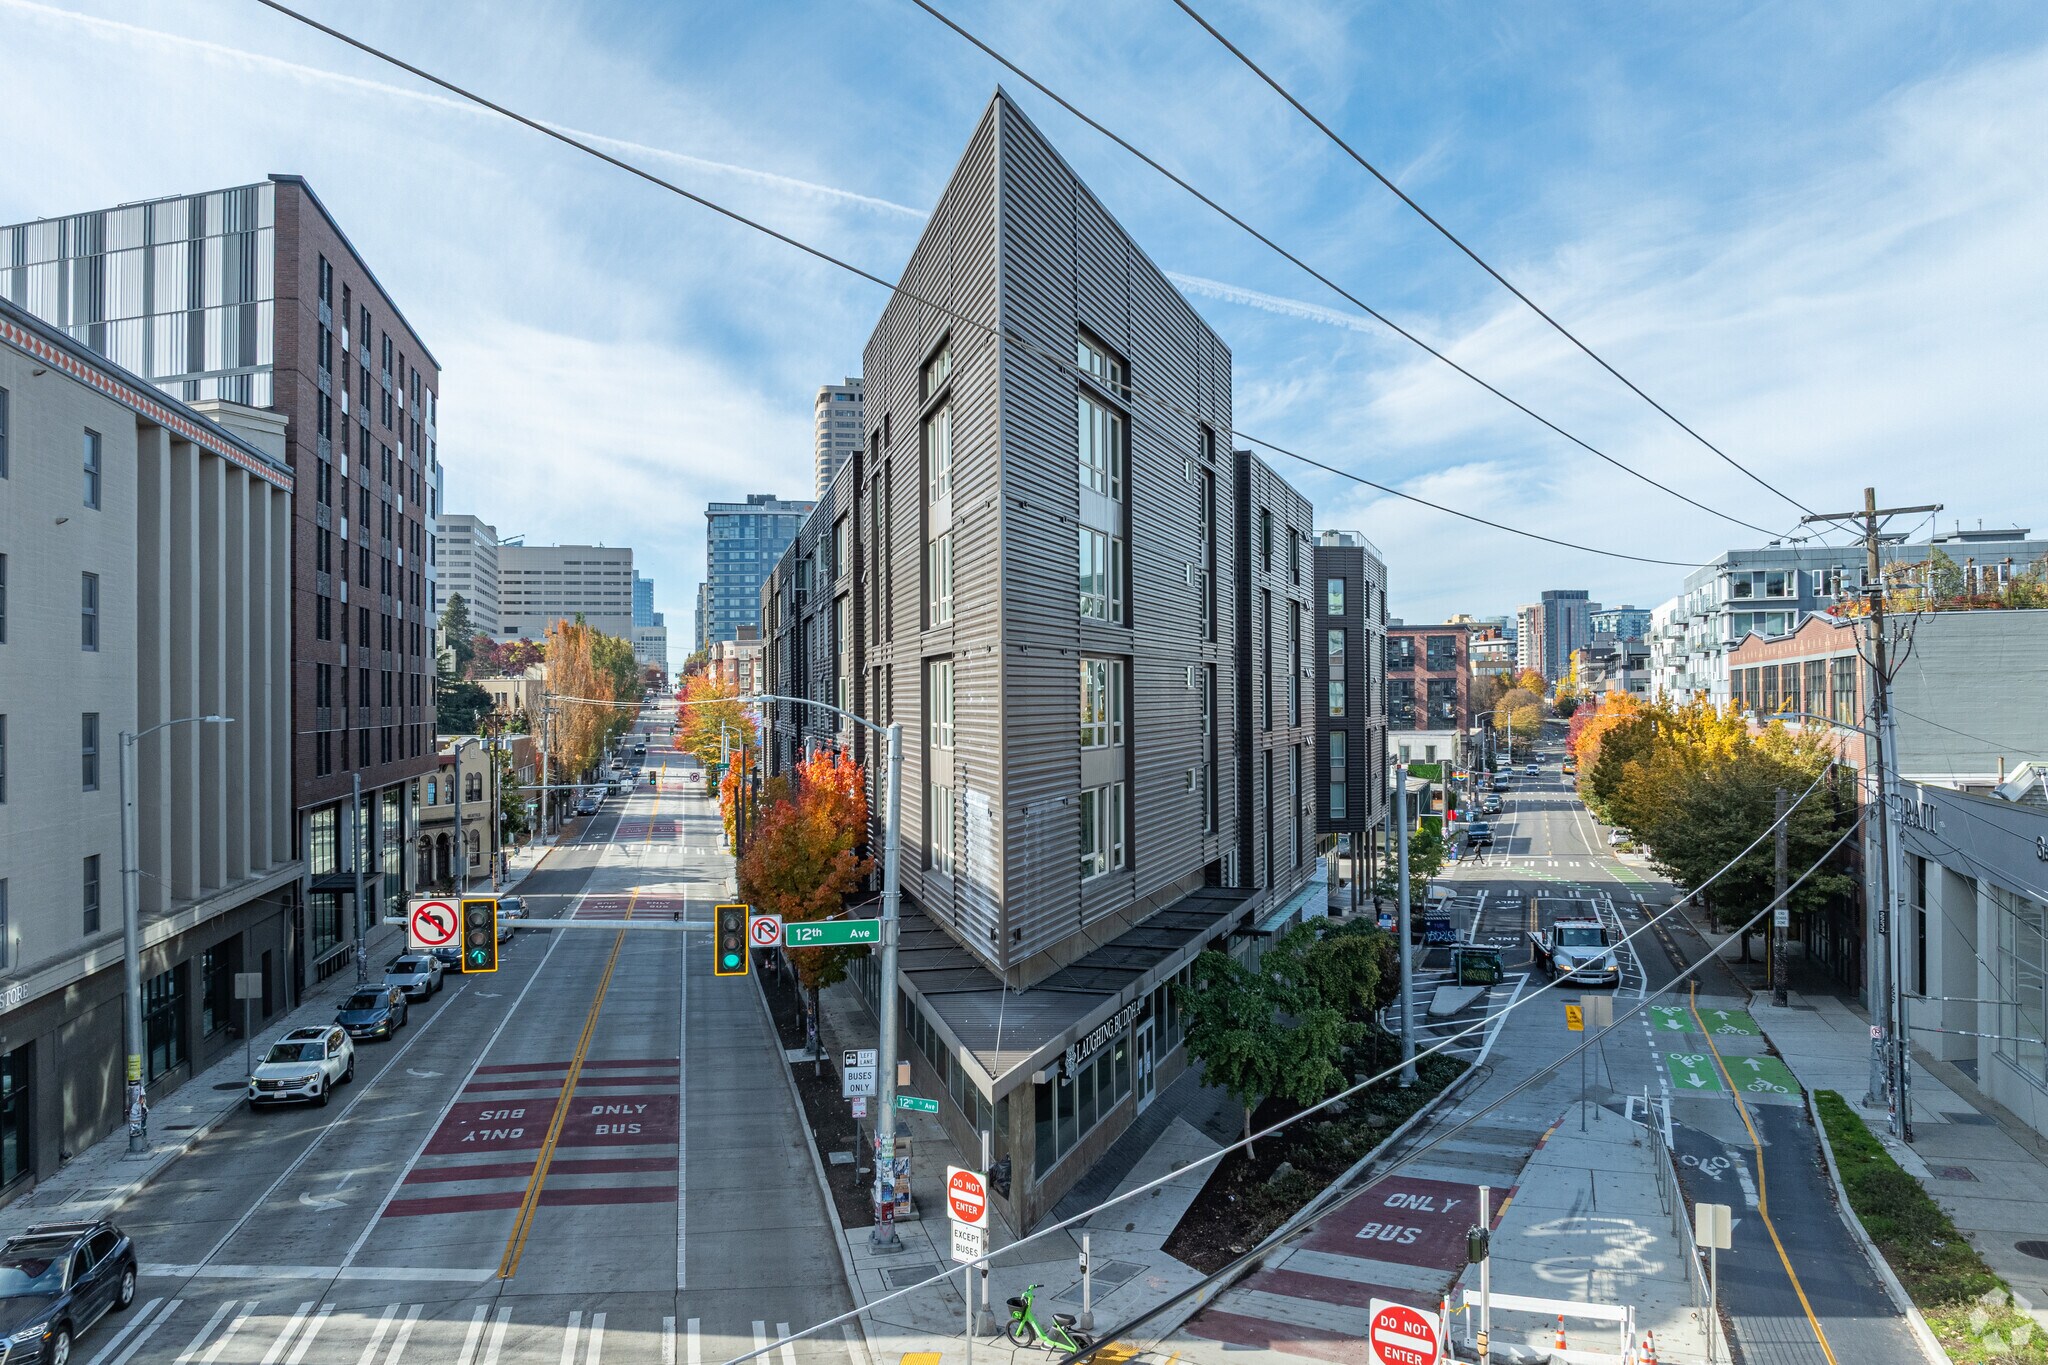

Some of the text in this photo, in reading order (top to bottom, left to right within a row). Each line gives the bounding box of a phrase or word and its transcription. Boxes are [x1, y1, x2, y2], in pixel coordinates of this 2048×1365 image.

[796, 928, 870, 941] 12th Ave
[0, 982, 29, 1009] STORE
[1076, 1000, 1141, 1063] LAUGHING BUDDHA
[848, 1072, 872, 1080] BUSES
[850, 1084, 870, 1092] ONLY
[591, 1104, 648, 1115] ONLY
[899, 1097, 936, 1111] 12th Ave
[478, 1108, 526, 1121] BUS
[461, 1128, 525, 1142] ONLY
[595, 1123, 642, 1135] BUS
[953, 1178, 980, 1193] DO NOT
[955, 1201, 978, 1216] ENTER
[1383, 1193, 1462, 1213] ONLY
[954, 1229, 980, 1244] EXCEPT
[1355, 1222, 1423, 1244] BUS
[955, 1243, 979, 1258] BUSES
[1380, 1315, 1428, 1337] DO NOT
[1384, 1346, 1423, 1365] ENTER
